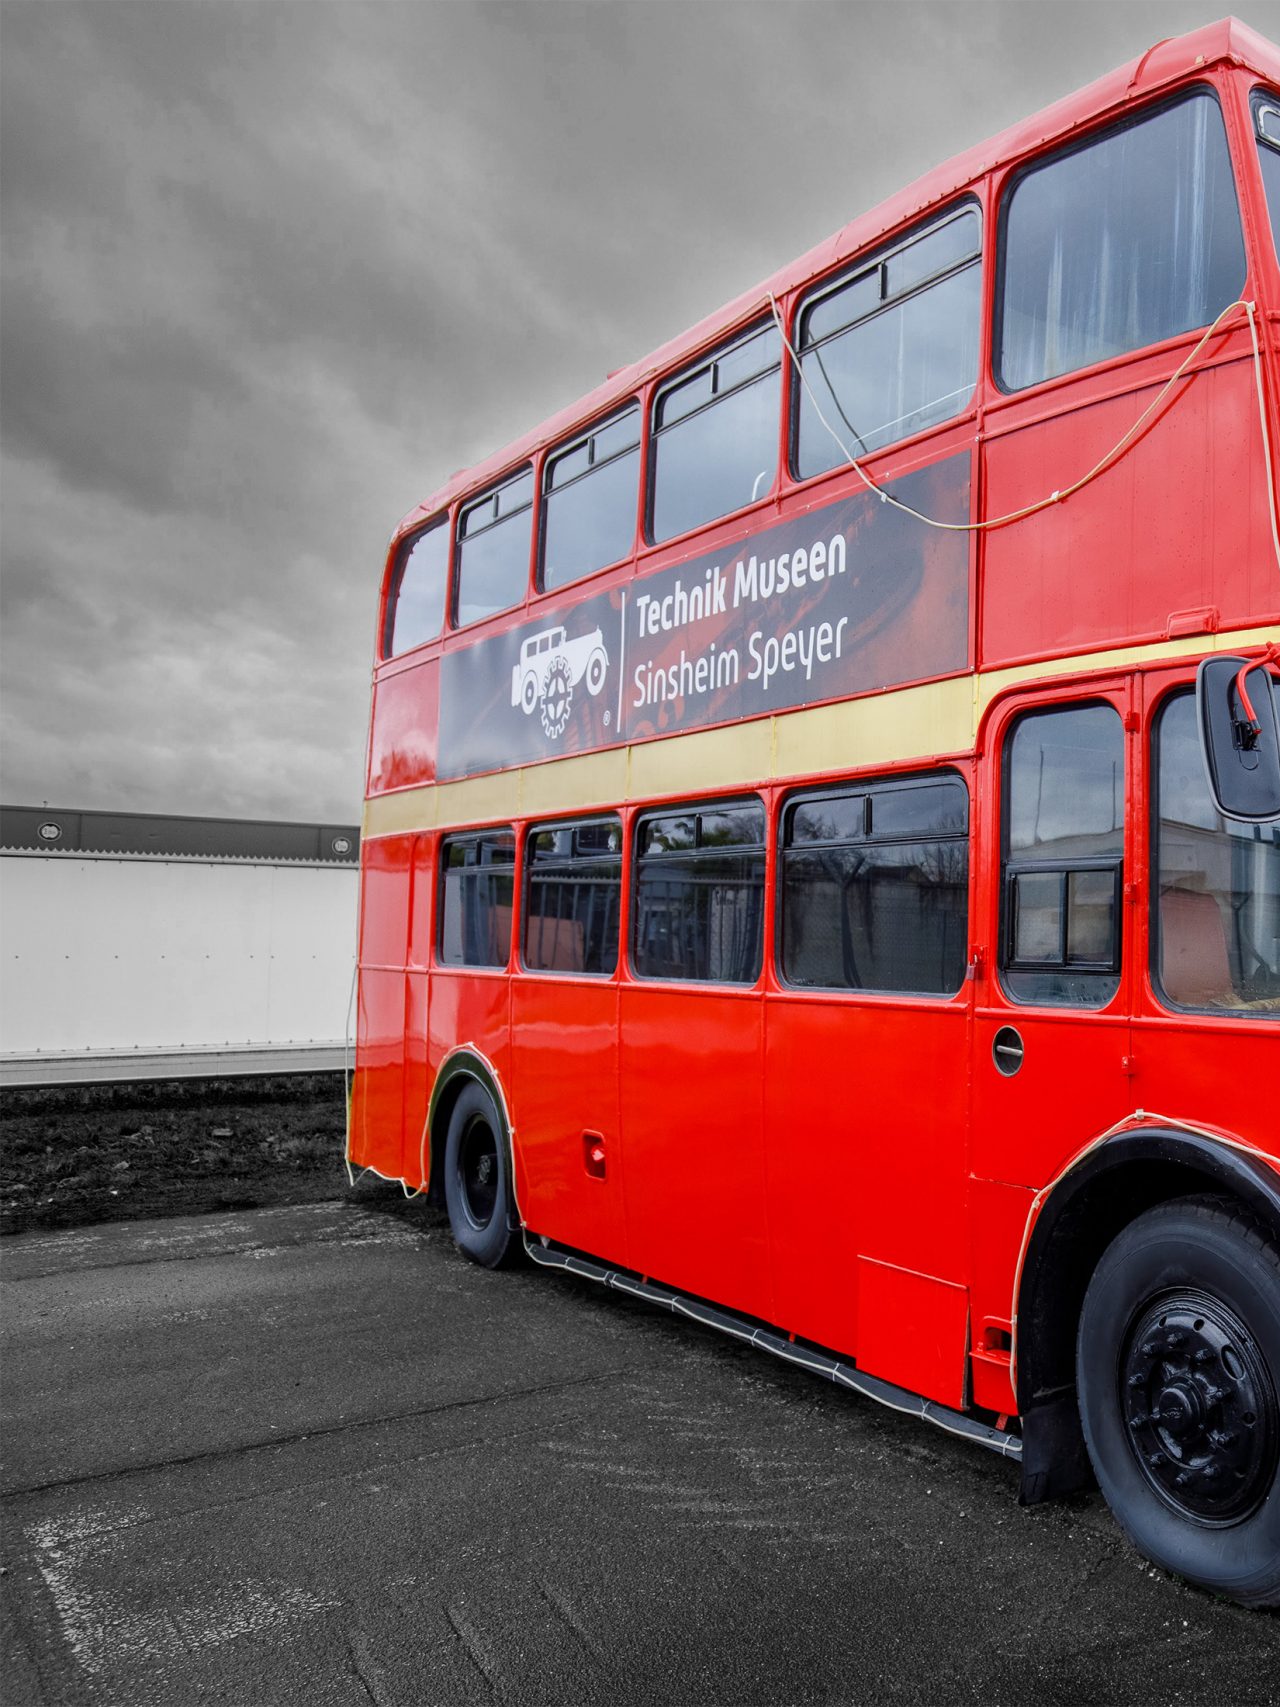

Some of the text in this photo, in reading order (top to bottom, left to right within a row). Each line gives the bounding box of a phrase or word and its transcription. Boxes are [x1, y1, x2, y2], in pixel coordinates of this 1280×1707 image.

[636, 534, 846, 638] Technik Museen
[633, 617, 848, 708] Sinsheim Speyer
